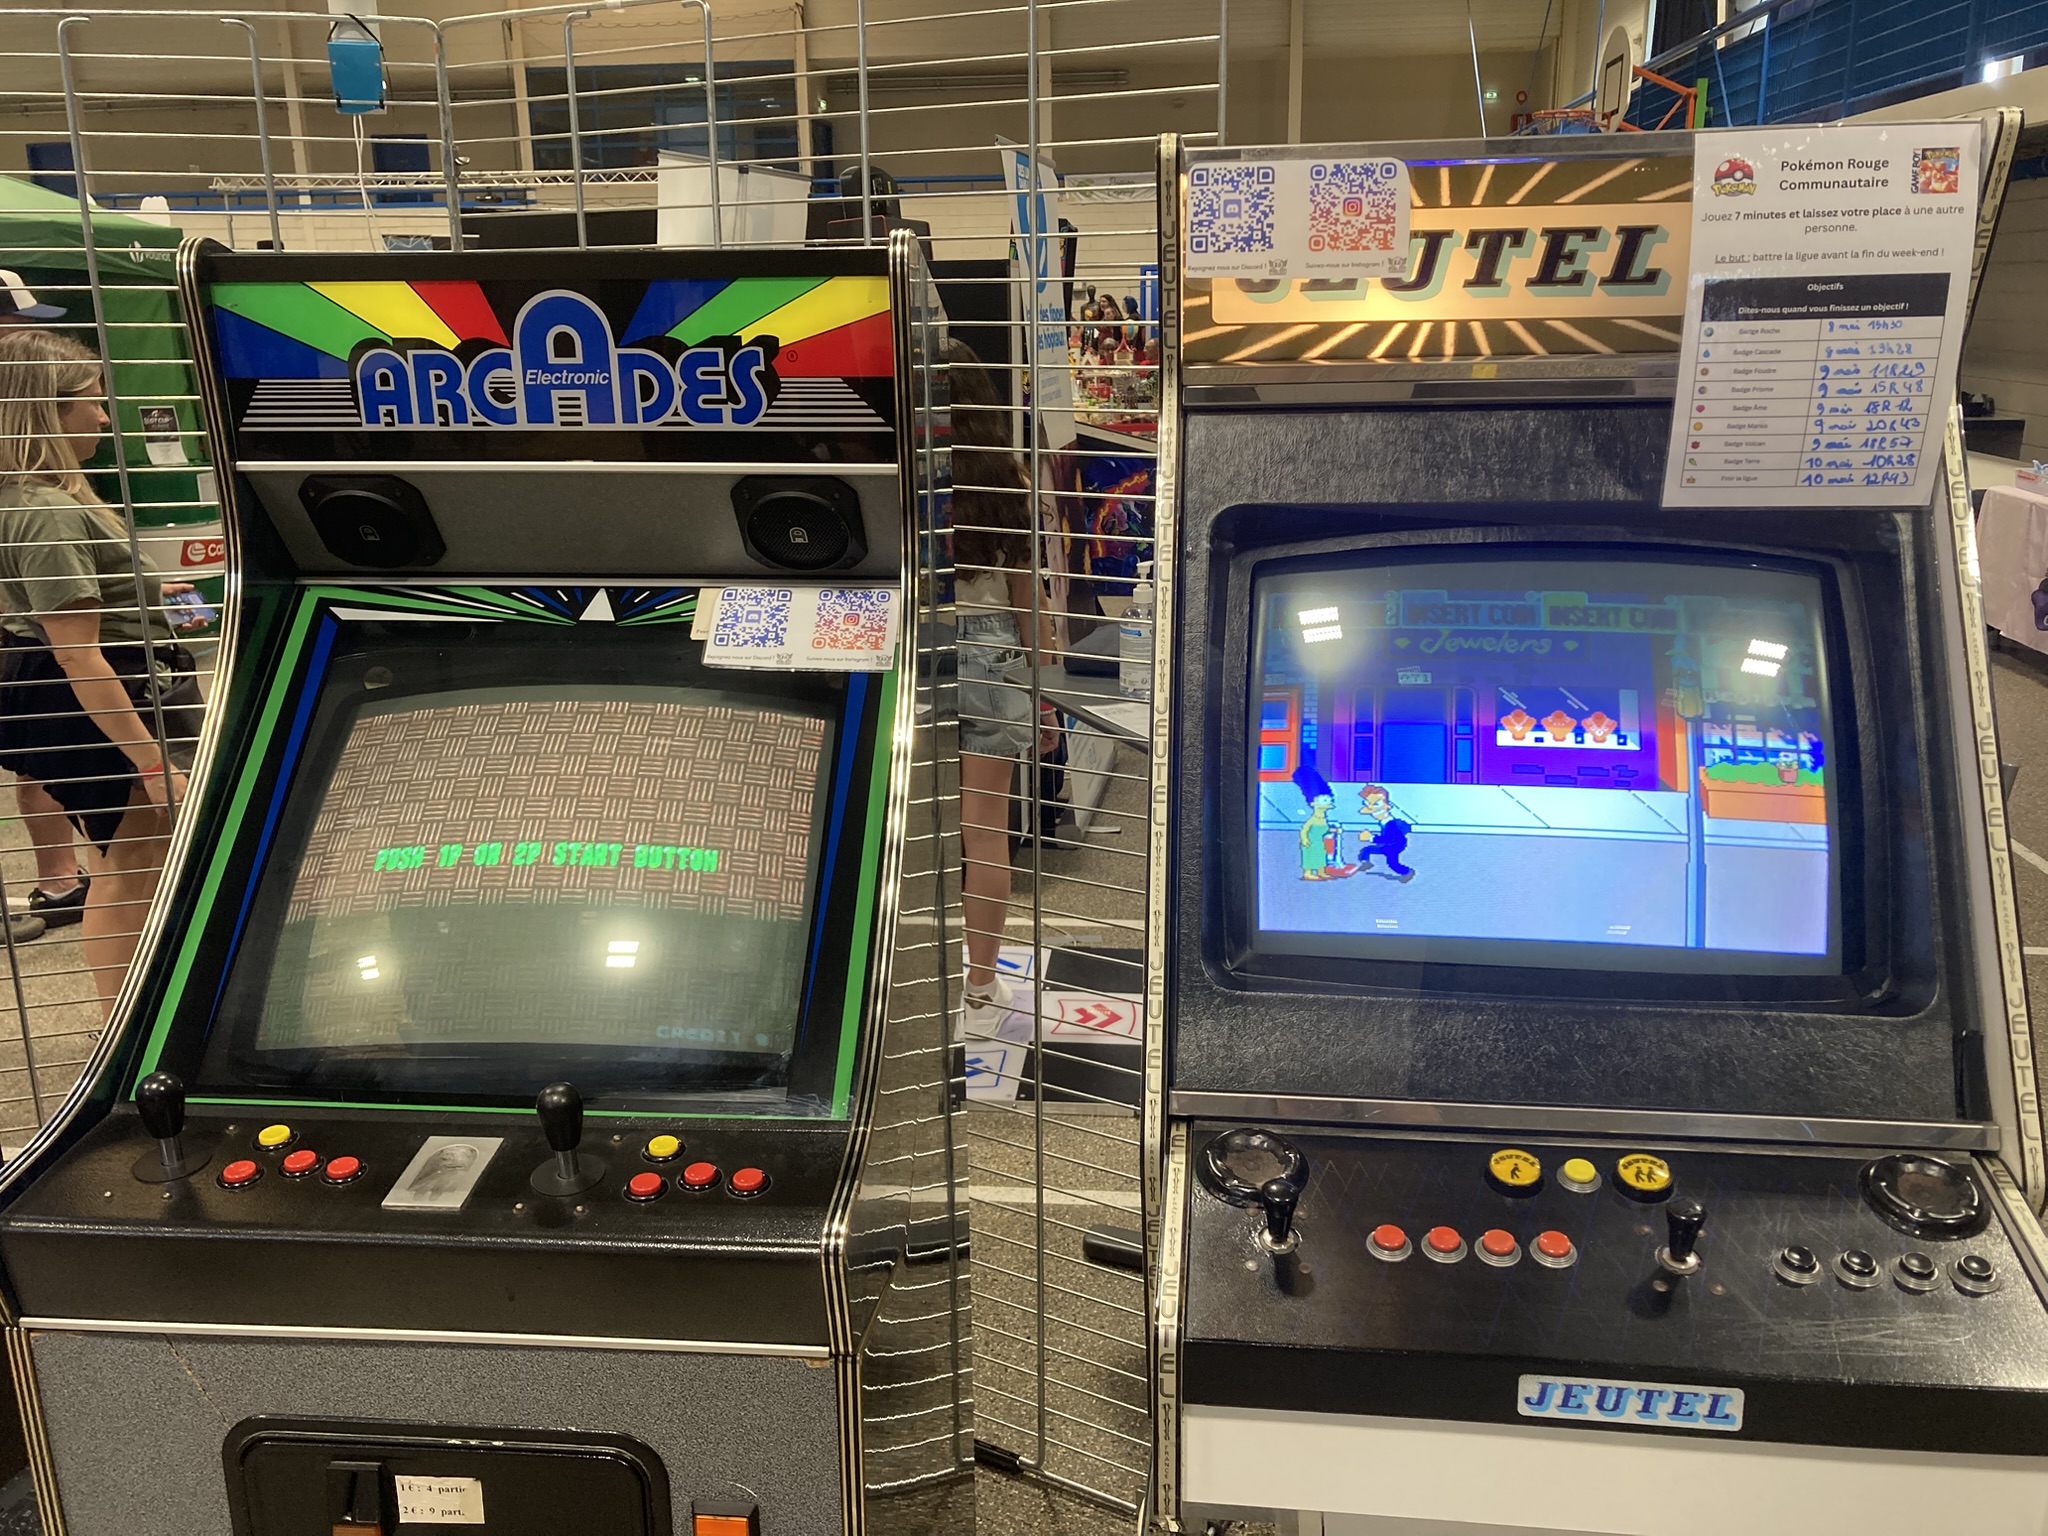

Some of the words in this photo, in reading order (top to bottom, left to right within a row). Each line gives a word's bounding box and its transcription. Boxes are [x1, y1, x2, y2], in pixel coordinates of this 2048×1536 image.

[1781, 159, 1843, 171] Pokémon
[1848, 158, 1889, 171] Rouge
[1779, 177, 1889, 191] Communautaire
[1701, 212, 1733, 222] Jouez
[1735, 211, 1741, 220] 7
[1743, 210, 1787, 220] minutes
[1789, 210, 1800, 219] et
[1803, 208, 1838, 218] laissez
[1841, 208, 1870, 217] votre
[1872, 206, 1902, 218] place
[1904, 205, 1910, 215] à
[1913, 206, 1933, 215] une
[1936, 205, 1965, 214] autre
[1804, 224, 1858, 235] personne.
[1715, 254, 1727, 263] Le
[1728, 253, 1745, 263] but
[1752, 252, 1783, 262] battre
[1785, 252, 1793, 260] la
[1796, 251, 1819, 262] ligue
[1821, 250, 1848, 260] avant
[1850, 250, 1859, 259] la
[1861, 249, 1874, 258] fin
[1877, 248, 1889, 258] du
[1892, 248, 1939, 257] week-end
[1234, 225, 1674, 303] UTEL
[1241, 262, 1264, 270] Discord
[1351, 261, 1380, 270] Instagram
[1162, 220, 1176, 350] JEUTEL
[1807, 282, 1844, 291] Objectifs
[1738, 306, 1781, 314] Dites-nous
[1782, 304, 1808, 315] quand
[1809, 305, 1828, 313] vous
[1829, 303, 1860, 313] finissez
[1873, 302, 1905, 312] objectif
[355, 289, 768, 428] ARCADES
[525, 368, 611, 387] Electronic
[1819, 364, 1830, 380] 9
[1816, 402, 1825, 416] 9
[1814, 418, 1824, 434] 9
[1805, 457, 1823, 468] 10
[1801, 473, 1824, 486] 10
[1158, 462, 1175, 583] JEUTEL
[1949, 459, 1977, 588] JEUTEL
[1420, 629, 1553, 654] Jewelers
[1152, 697, 1169, 827] JEUTEL
[1977, 711, 2007, 852] JEUTEL
[373, 845, 426, 872] PUSH
[438, 843, 463, 867] 1P
[512, 841, 542, 866] 2P
[552, 841, 624, 867] START
[633, 844, 719, 873] BUTTON
[1146, 951, 1164, 1094] JEUTEL
[2008, 986, 2040, 1141] JEUTEL
[1493, 1154, 1538, 1168] JEUTEL
[1622, 1157, 1666, 1171] JEUTEL
[1159, 1260, 1179, 1399] JEUTEL
[1524, 1381, 1738, 1427] JEUTEL
[426, 1484, 433, 1492] 4
[429, 1506, 436, 1515] 9
[441, 1508, 465, 1518] part.
